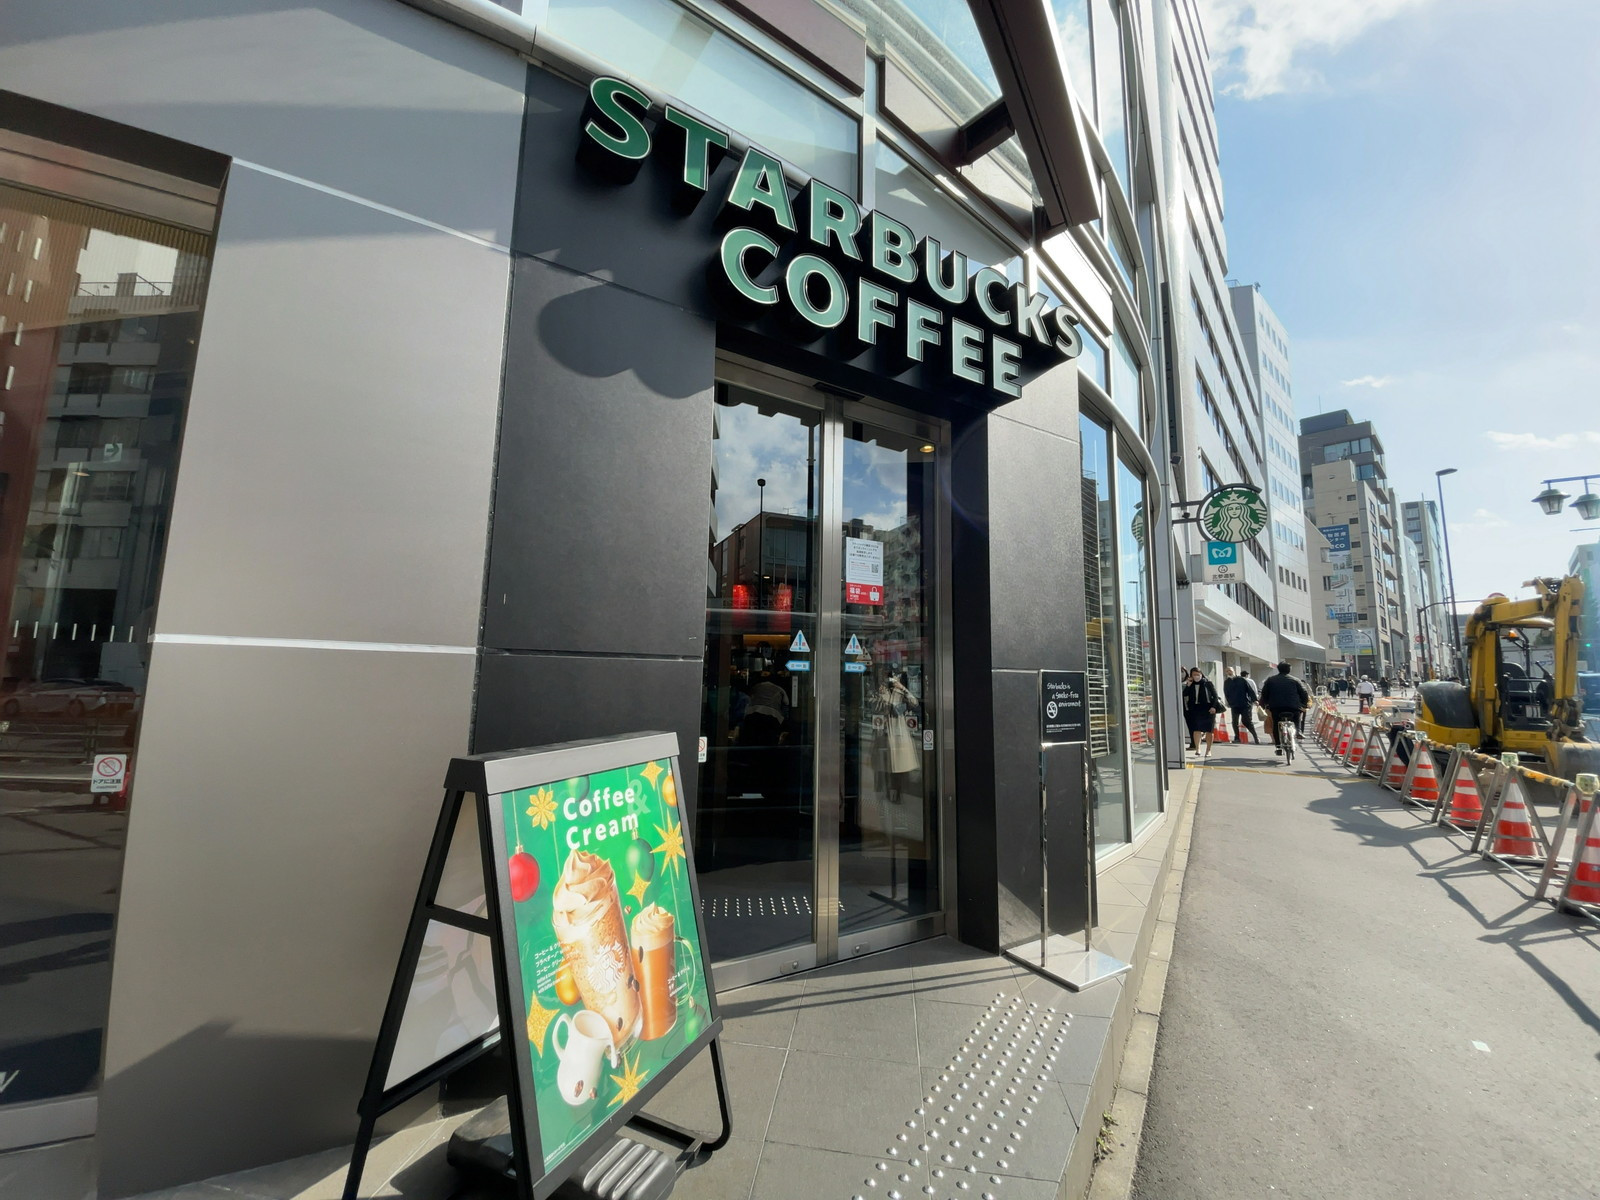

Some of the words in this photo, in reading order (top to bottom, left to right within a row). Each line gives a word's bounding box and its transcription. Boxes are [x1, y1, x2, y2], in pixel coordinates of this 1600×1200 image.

[585, 76, 1083, 357] STARBUCKS
[720, 225, 1023, 398] COFFEE
[563, 786, 635, 821] Coffee
[565, 813, 639, 850] Cream
